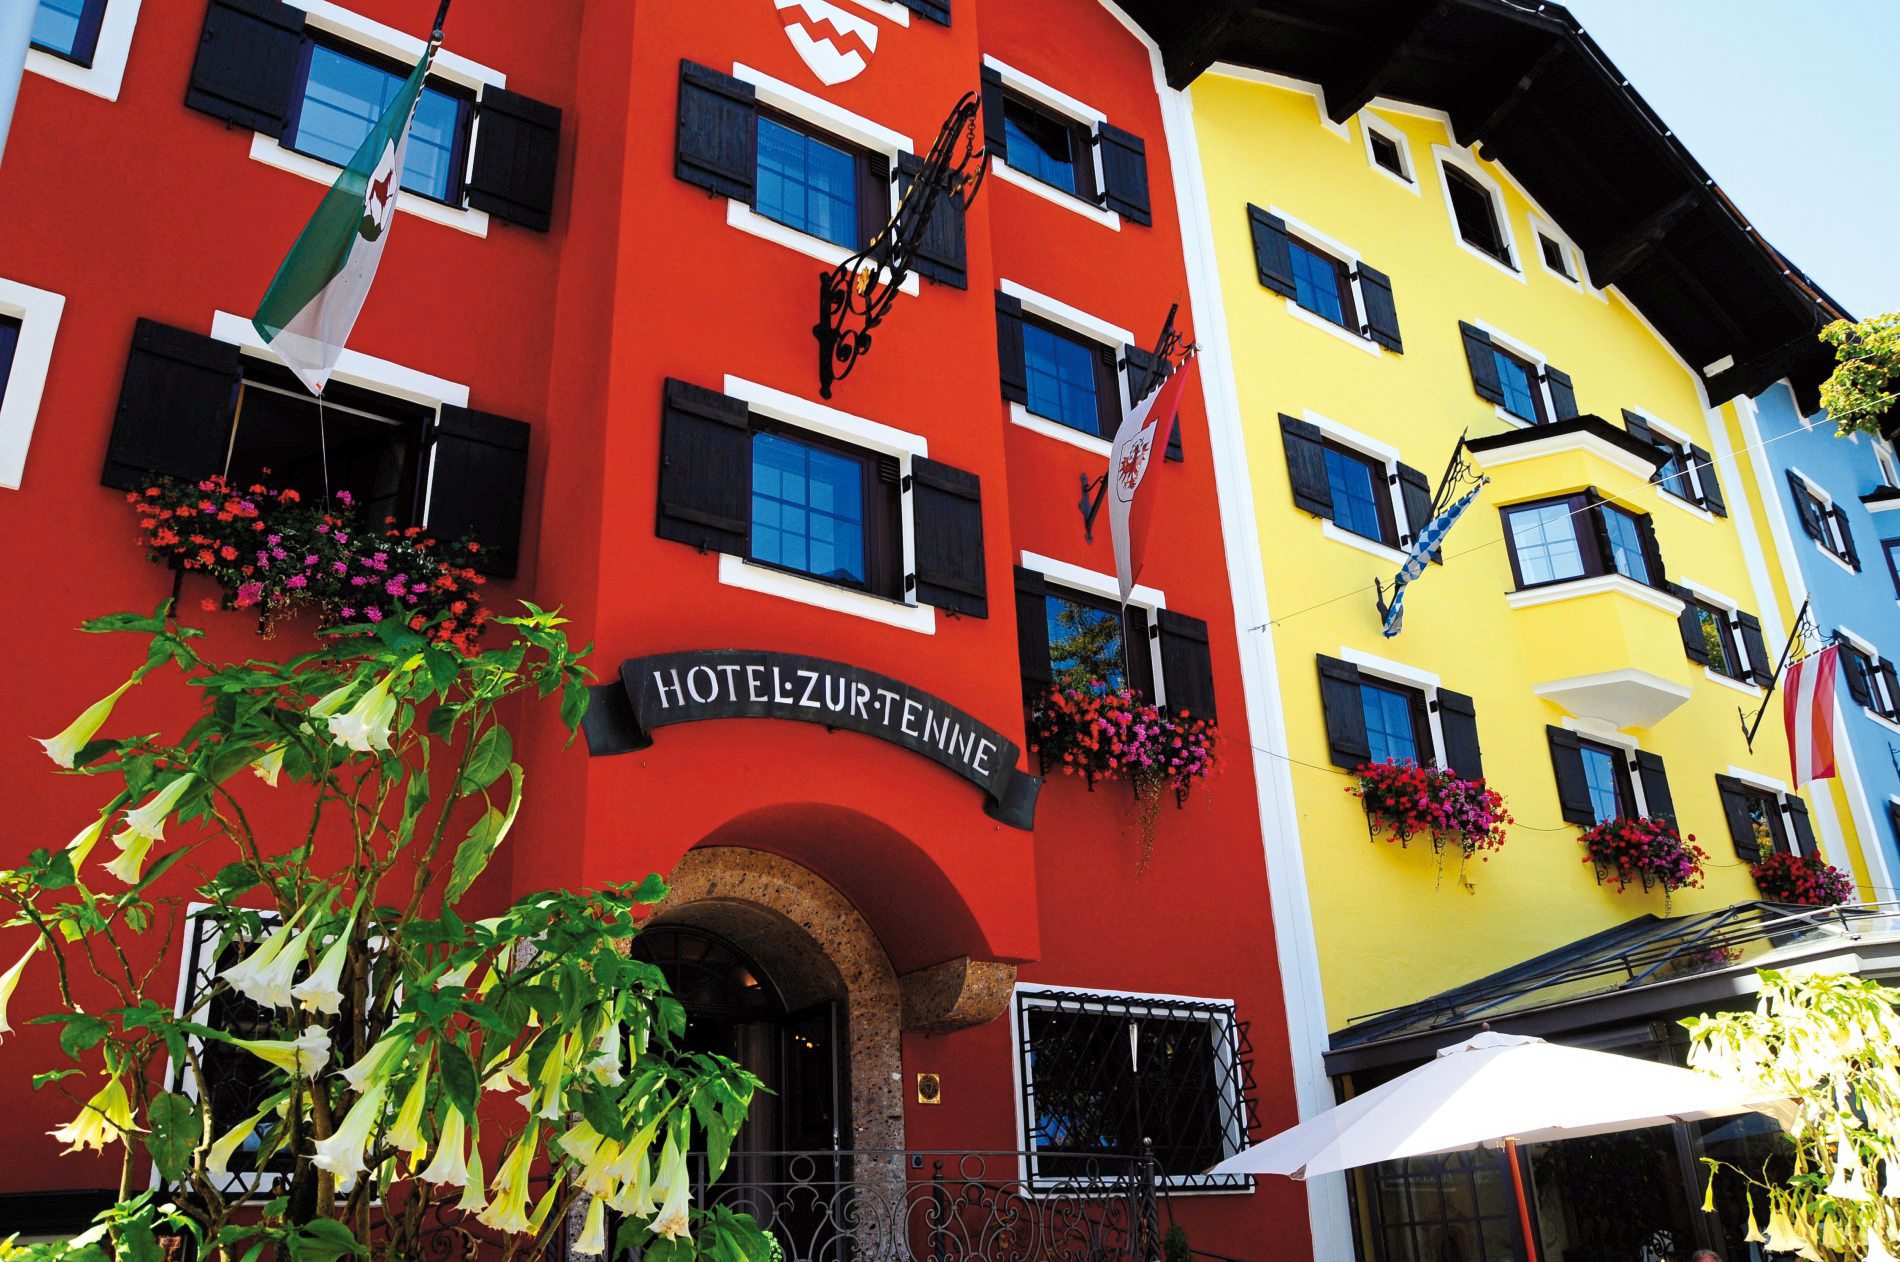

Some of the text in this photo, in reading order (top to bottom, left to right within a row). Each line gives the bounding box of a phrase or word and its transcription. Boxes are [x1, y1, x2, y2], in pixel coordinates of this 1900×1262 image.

[652, 664, 998, 777] HOTEL ZUR TENNE
